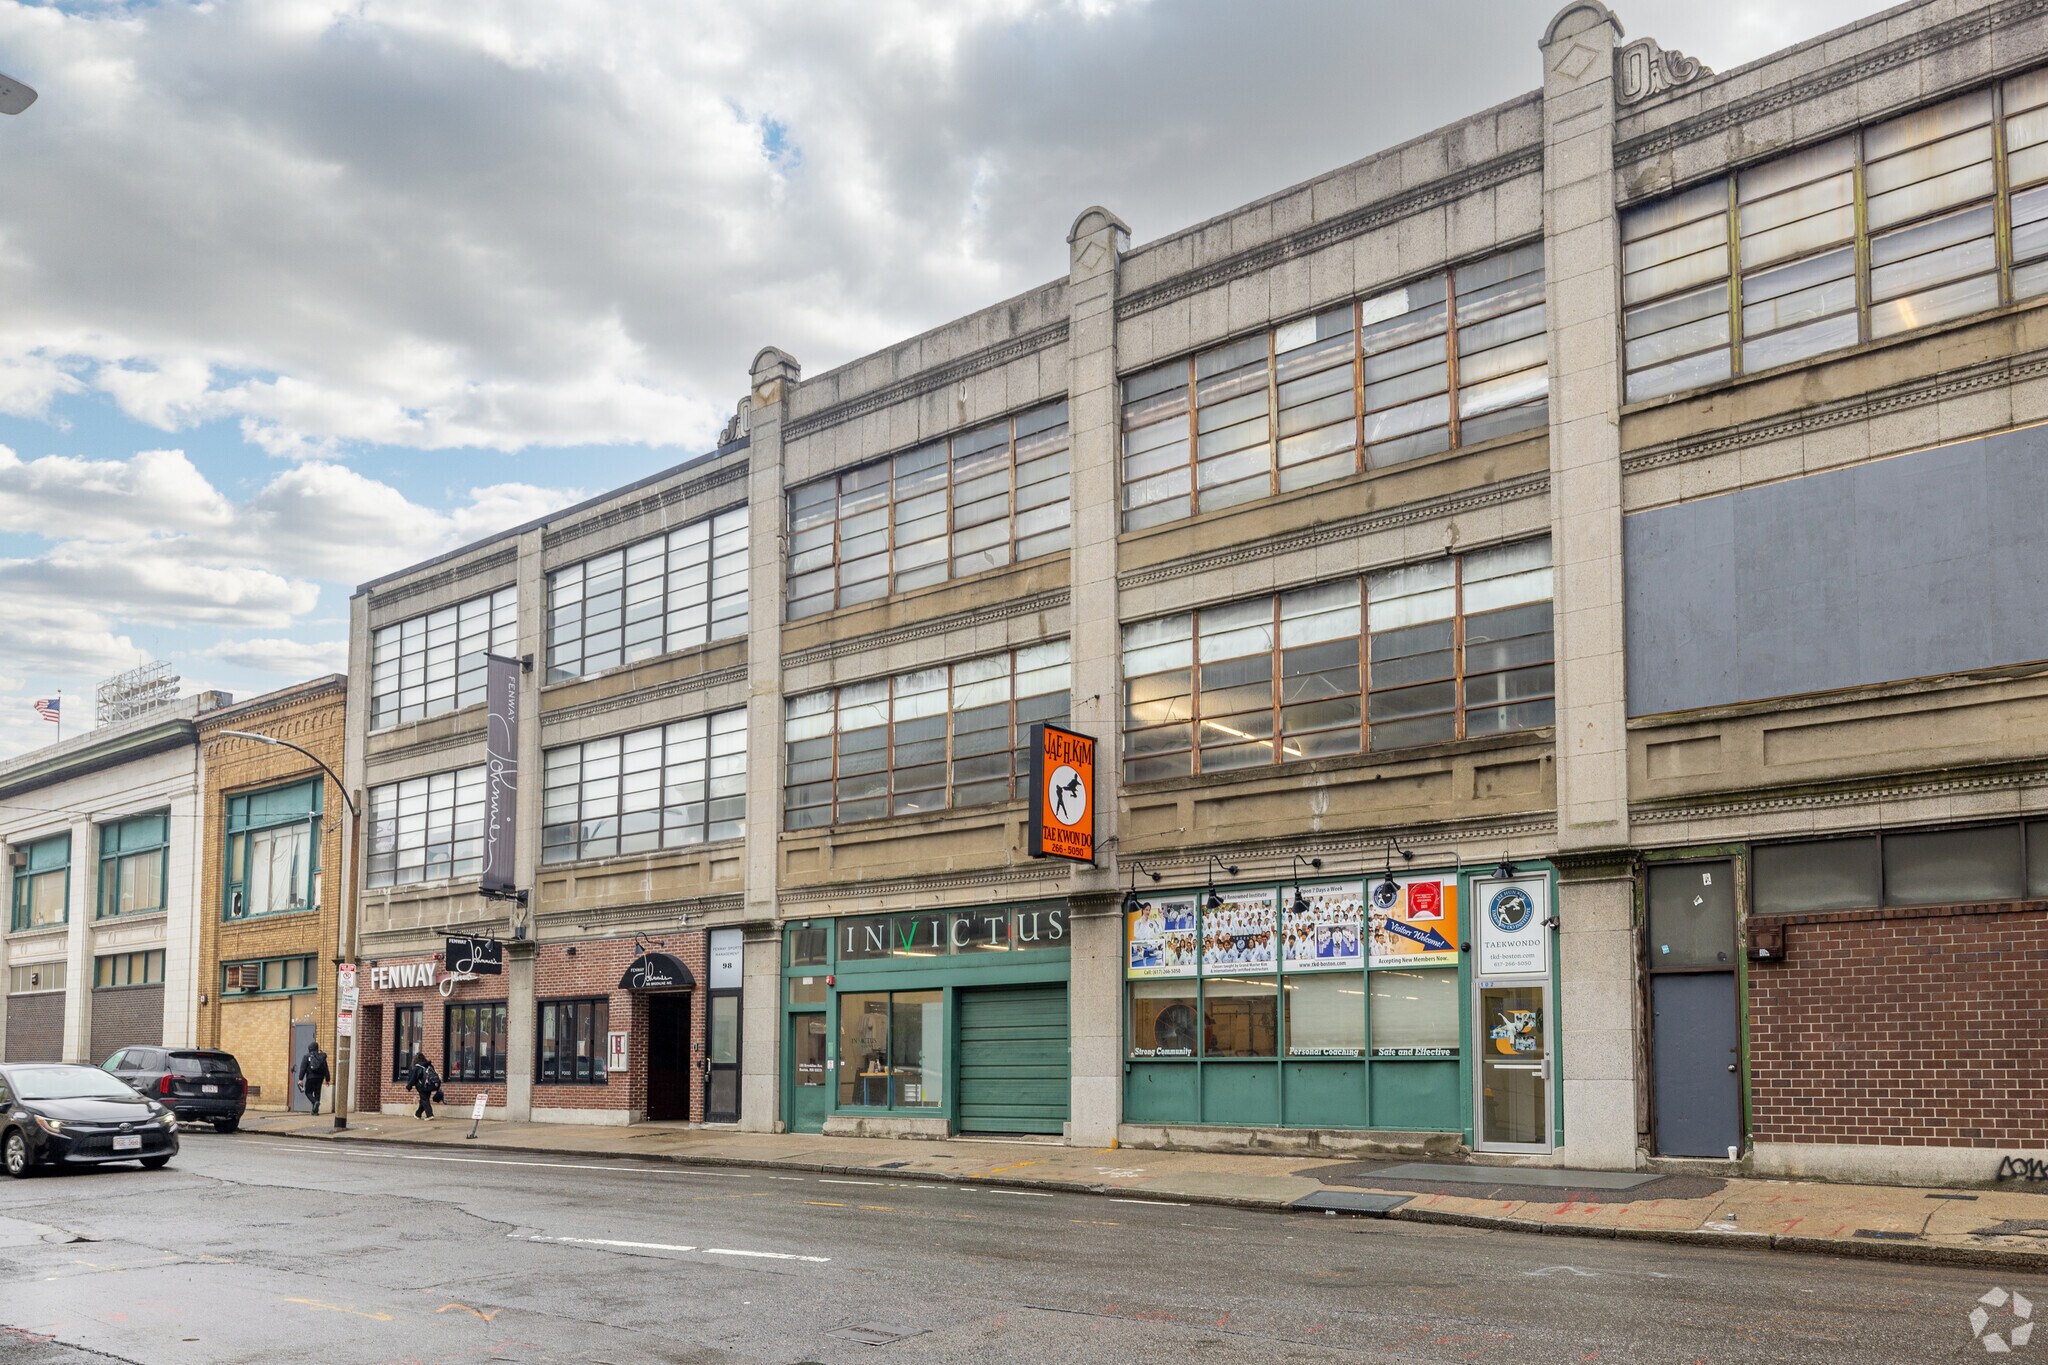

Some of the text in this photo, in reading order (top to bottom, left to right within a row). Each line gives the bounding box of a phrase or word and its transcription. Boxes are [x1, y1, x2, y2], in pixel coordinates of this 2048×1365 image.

[1044, 732, 1062, 761] JAE
[1072, 740, 1092, 767] KIM
[1043, 826, 1092, 848] TAE KWON DO
[1052, 844, 1084, 857] 266-5050
[846, 910, 1063, 956] INVICTUS
[1391, 921, 1444, 948] Visitors Welcome!
[1485, 940, 1540, 948] TAEKWONDO
[371, 962, 436, 990] FENWAY
[1135, 1046, 1191, 1056] Strong Community
[1289, 1047, 1359, 1057] Personal Coaching
[1378, 1047, 1450, 1056] Safe and Effective
